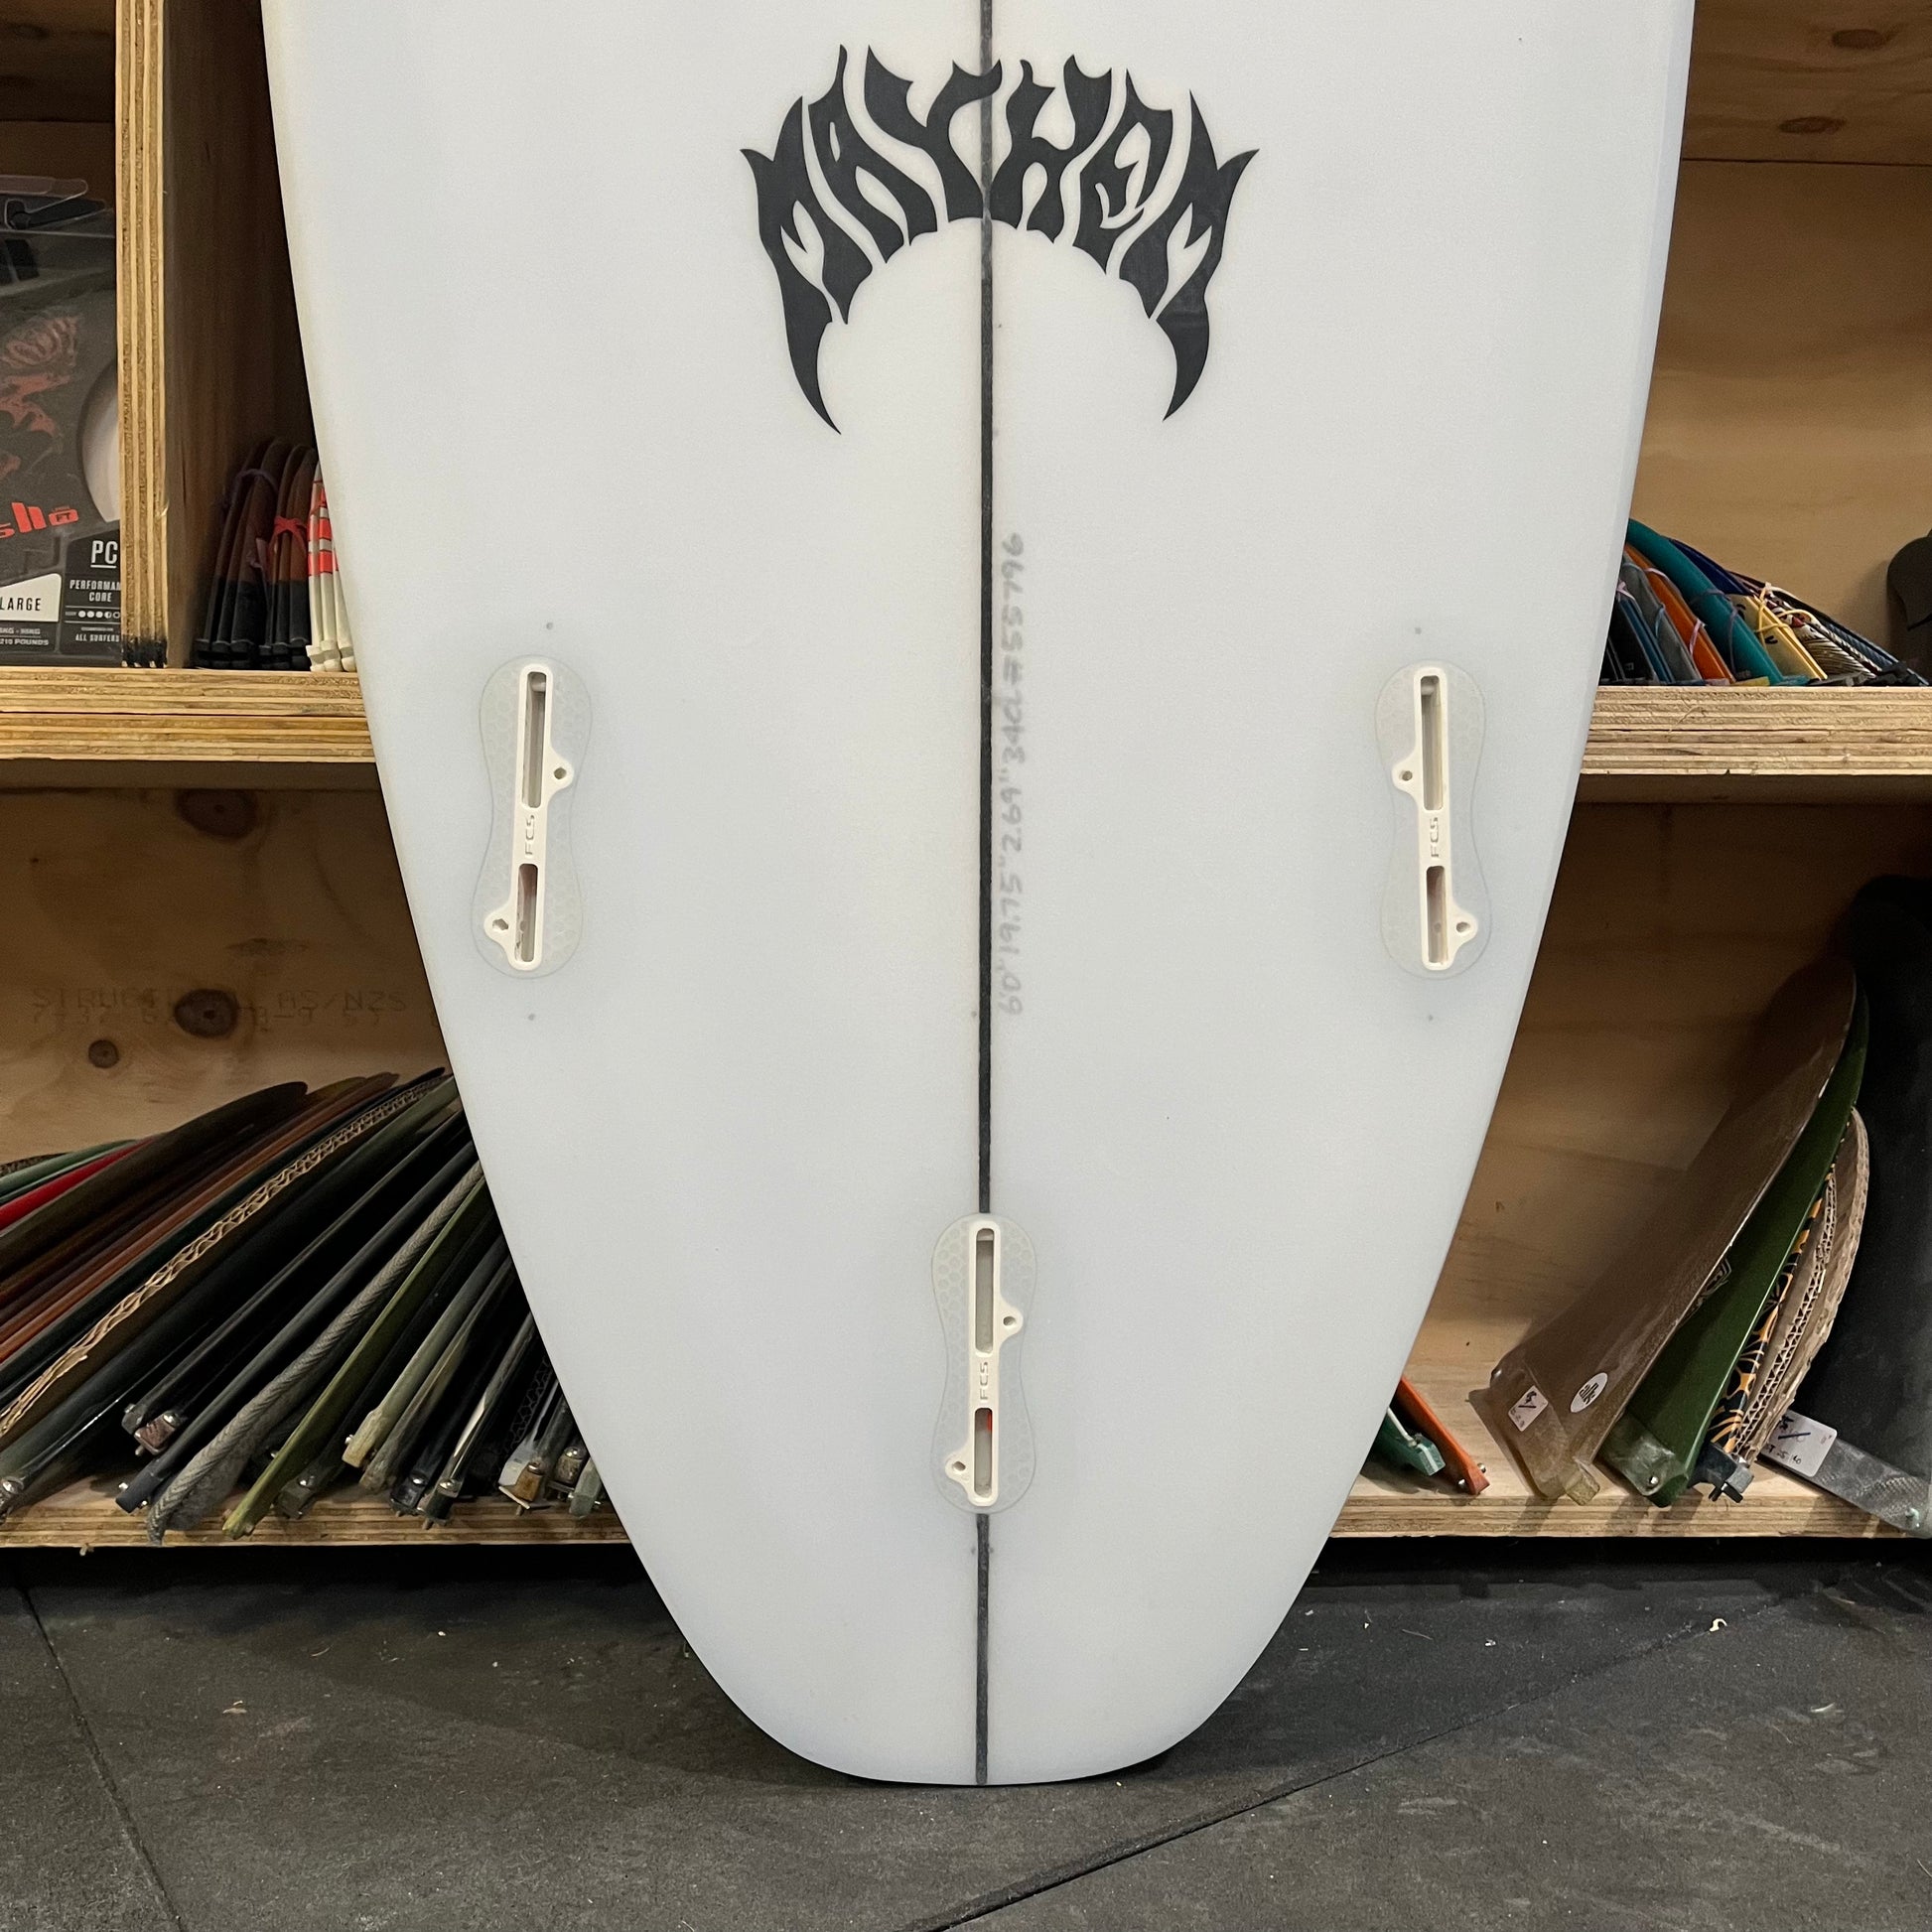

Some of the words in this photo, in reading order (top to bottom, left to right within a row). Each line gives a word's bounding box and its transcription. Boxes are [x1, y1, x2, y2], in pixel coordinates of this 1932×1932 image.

[740, 44, 1261, 436] MAYHEM
[90, 540, 118, 565] PC
[0, 597, 41, 612] LARGE
[88, 592, 112, 603] CORE
[524, 814, 535, 856] FCS
[1429, 816, 1440, 858] FCS
[979, 1361, 989, 1401] FCS
